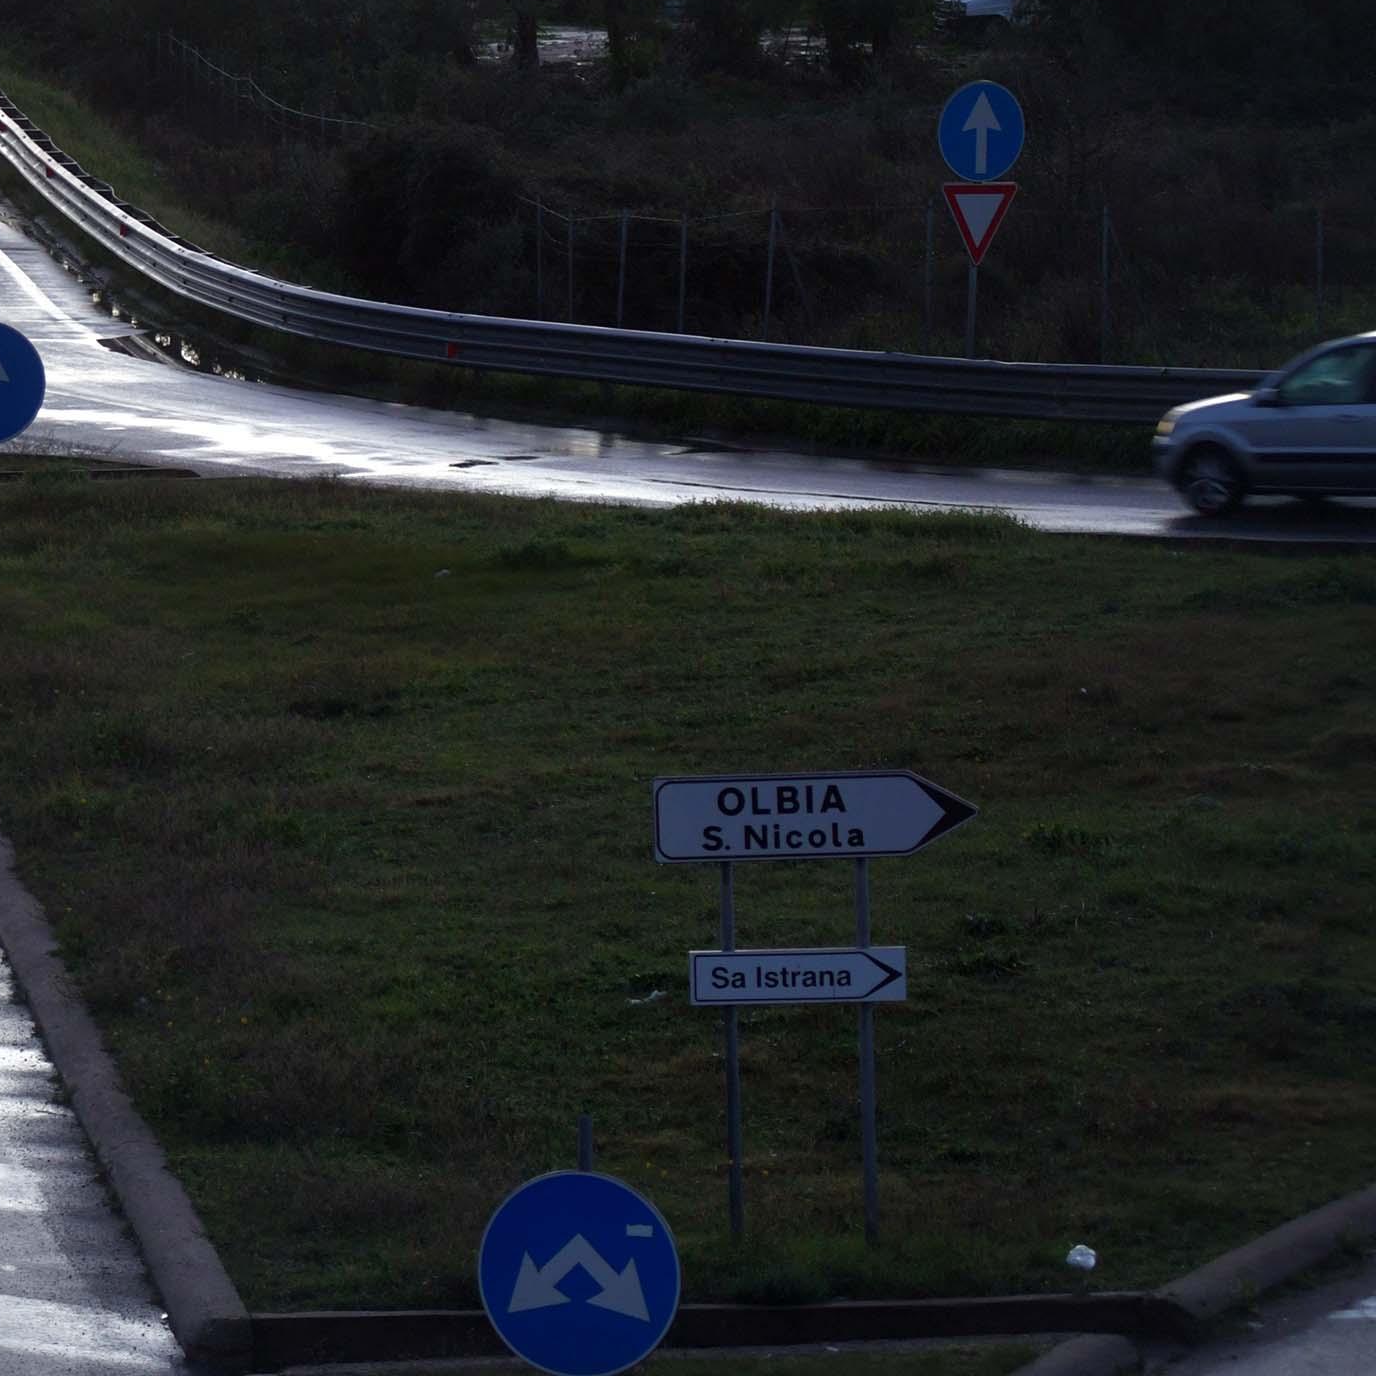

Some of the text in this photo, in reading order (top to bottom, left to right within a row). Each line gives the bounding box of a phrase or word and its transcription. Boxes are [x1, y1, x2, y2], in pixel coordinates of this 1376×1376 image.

[717, 784, 847, 816] OLBIA
[701, 822, 865, 851] S. Nicola
[711, 965, 852, 989] Sa Istrana
